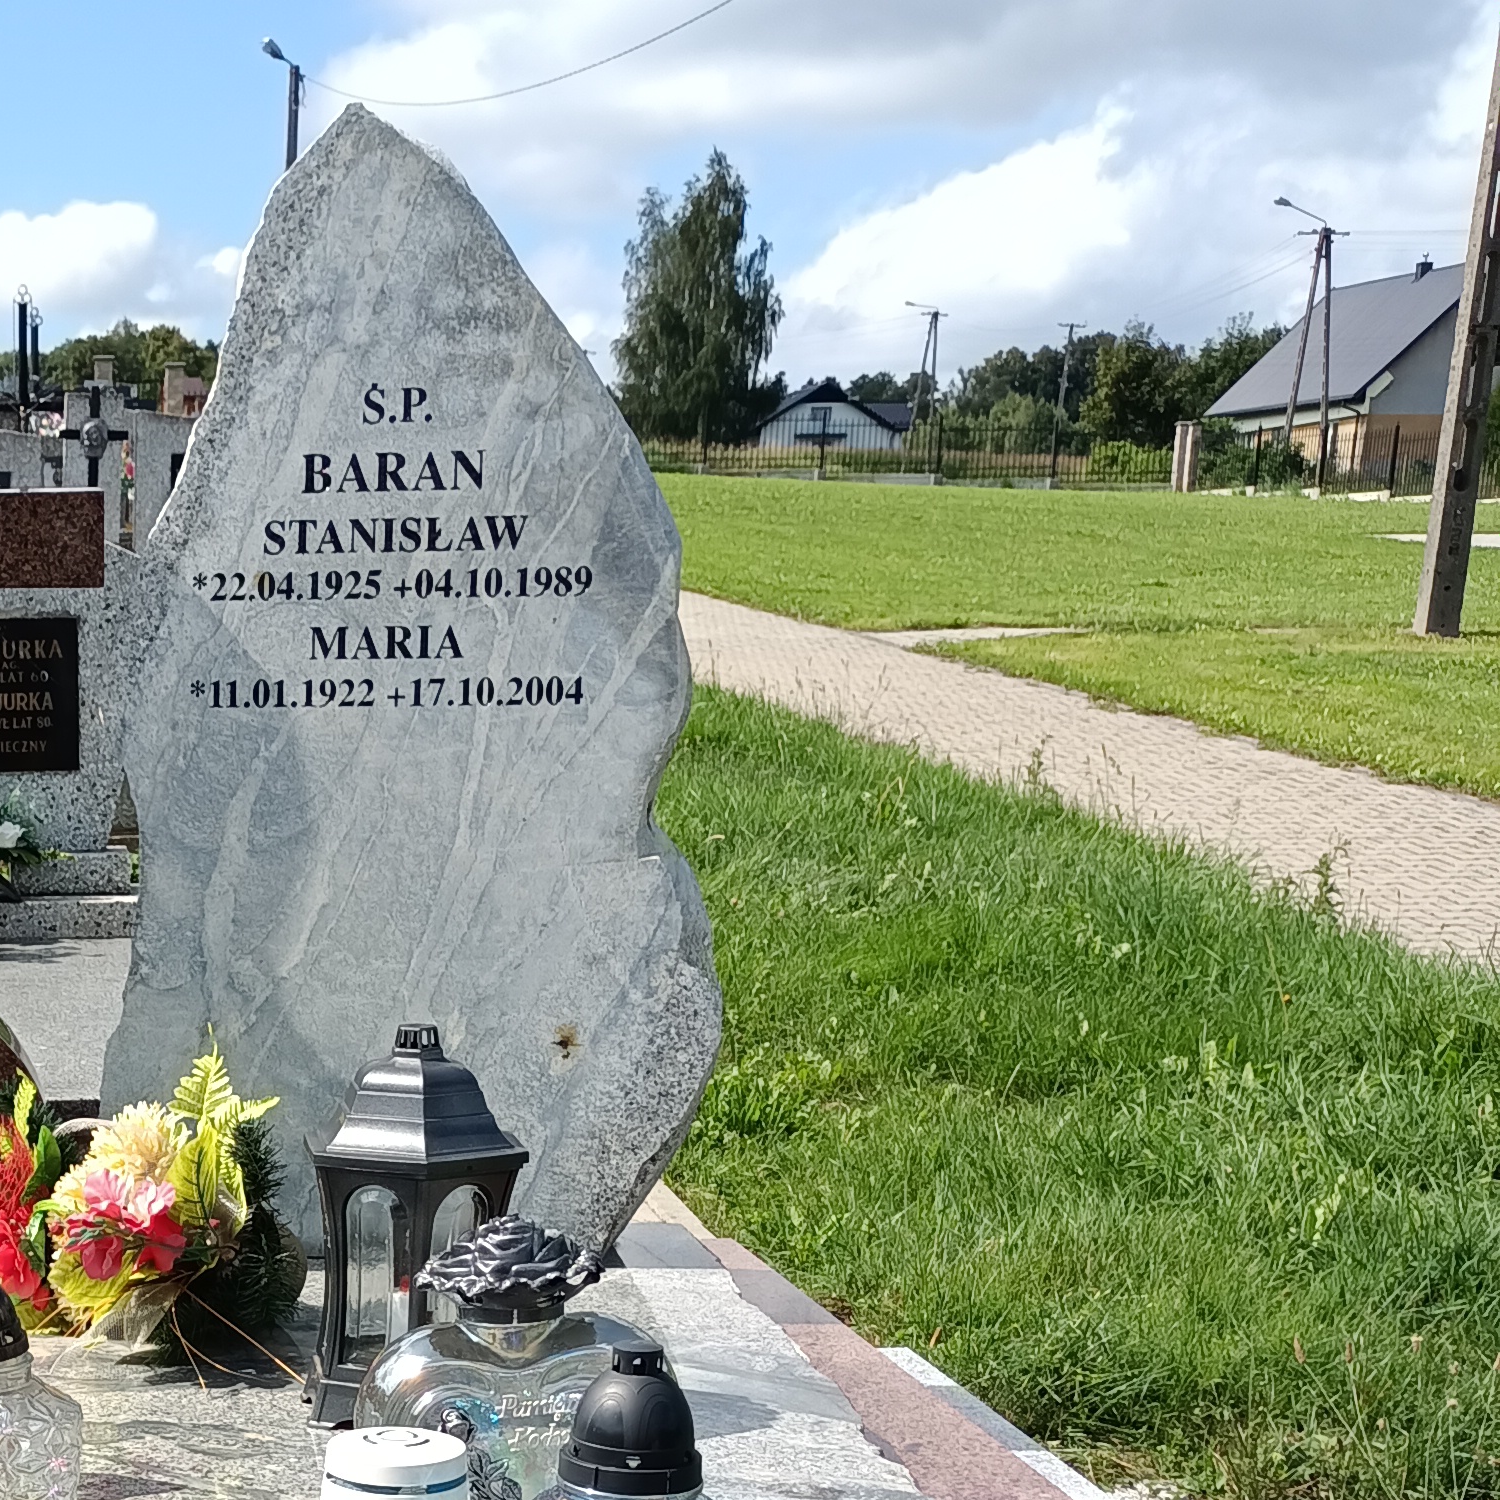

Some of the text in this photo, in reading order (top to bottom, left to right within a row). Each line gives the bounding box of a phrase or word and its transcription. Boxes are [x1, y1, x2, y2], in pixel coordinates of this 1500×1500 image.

[362, 382, 433, 425] Ś.P.
[301, 450, 484, 494] BARAN
[263, 514, 529, 556] STANISŁAW
[393, 565, 593, 599] +04.10.1989
[310, 625, 463, 660] MARIA
[0, 671, 24, 684] LAT
[387, 676, 584, 707] +17.10.2004
[13, 716, 32, 729] LAT
